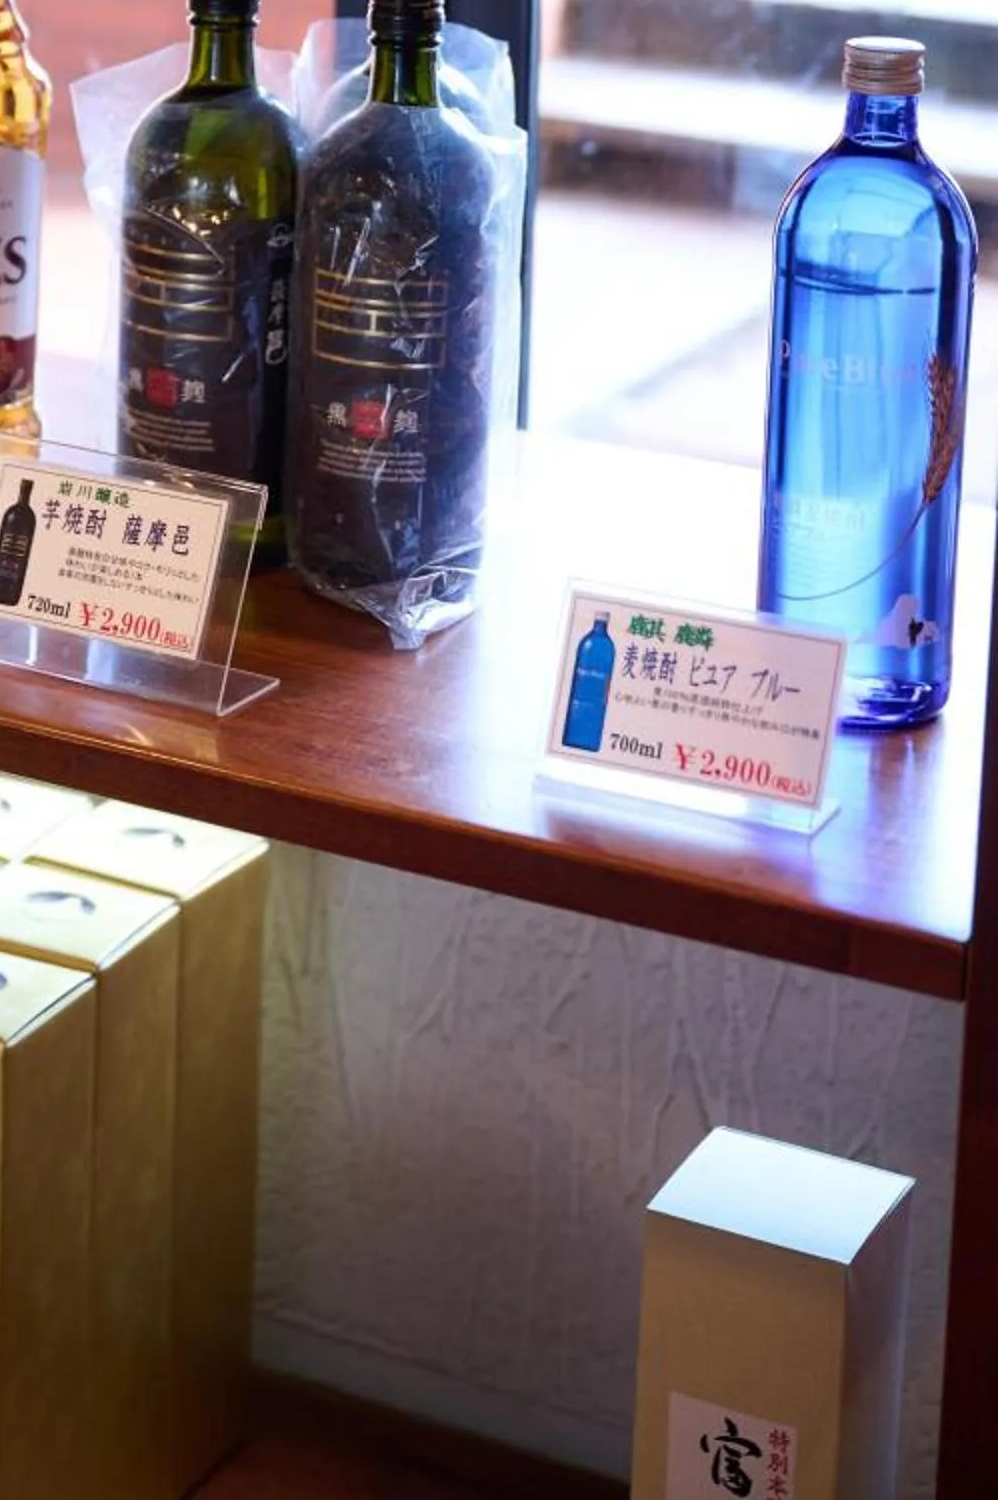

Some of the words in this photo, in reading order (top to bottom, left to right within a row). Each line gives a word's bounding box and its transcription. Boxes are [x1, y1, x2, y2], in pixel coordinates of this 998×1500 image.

[42, 499, 107, 540] 芋焼酎
[121, 512, 190, 556] 薩摩邑
[27, 594, 71, 619] 720ml
[622, 642, 678, 685] 麦焼酎
[609, 732, 663, 759] 700ml
[699, 1417, 762, 1498] 富
[767, 1428, 790, 1500] 特別本
